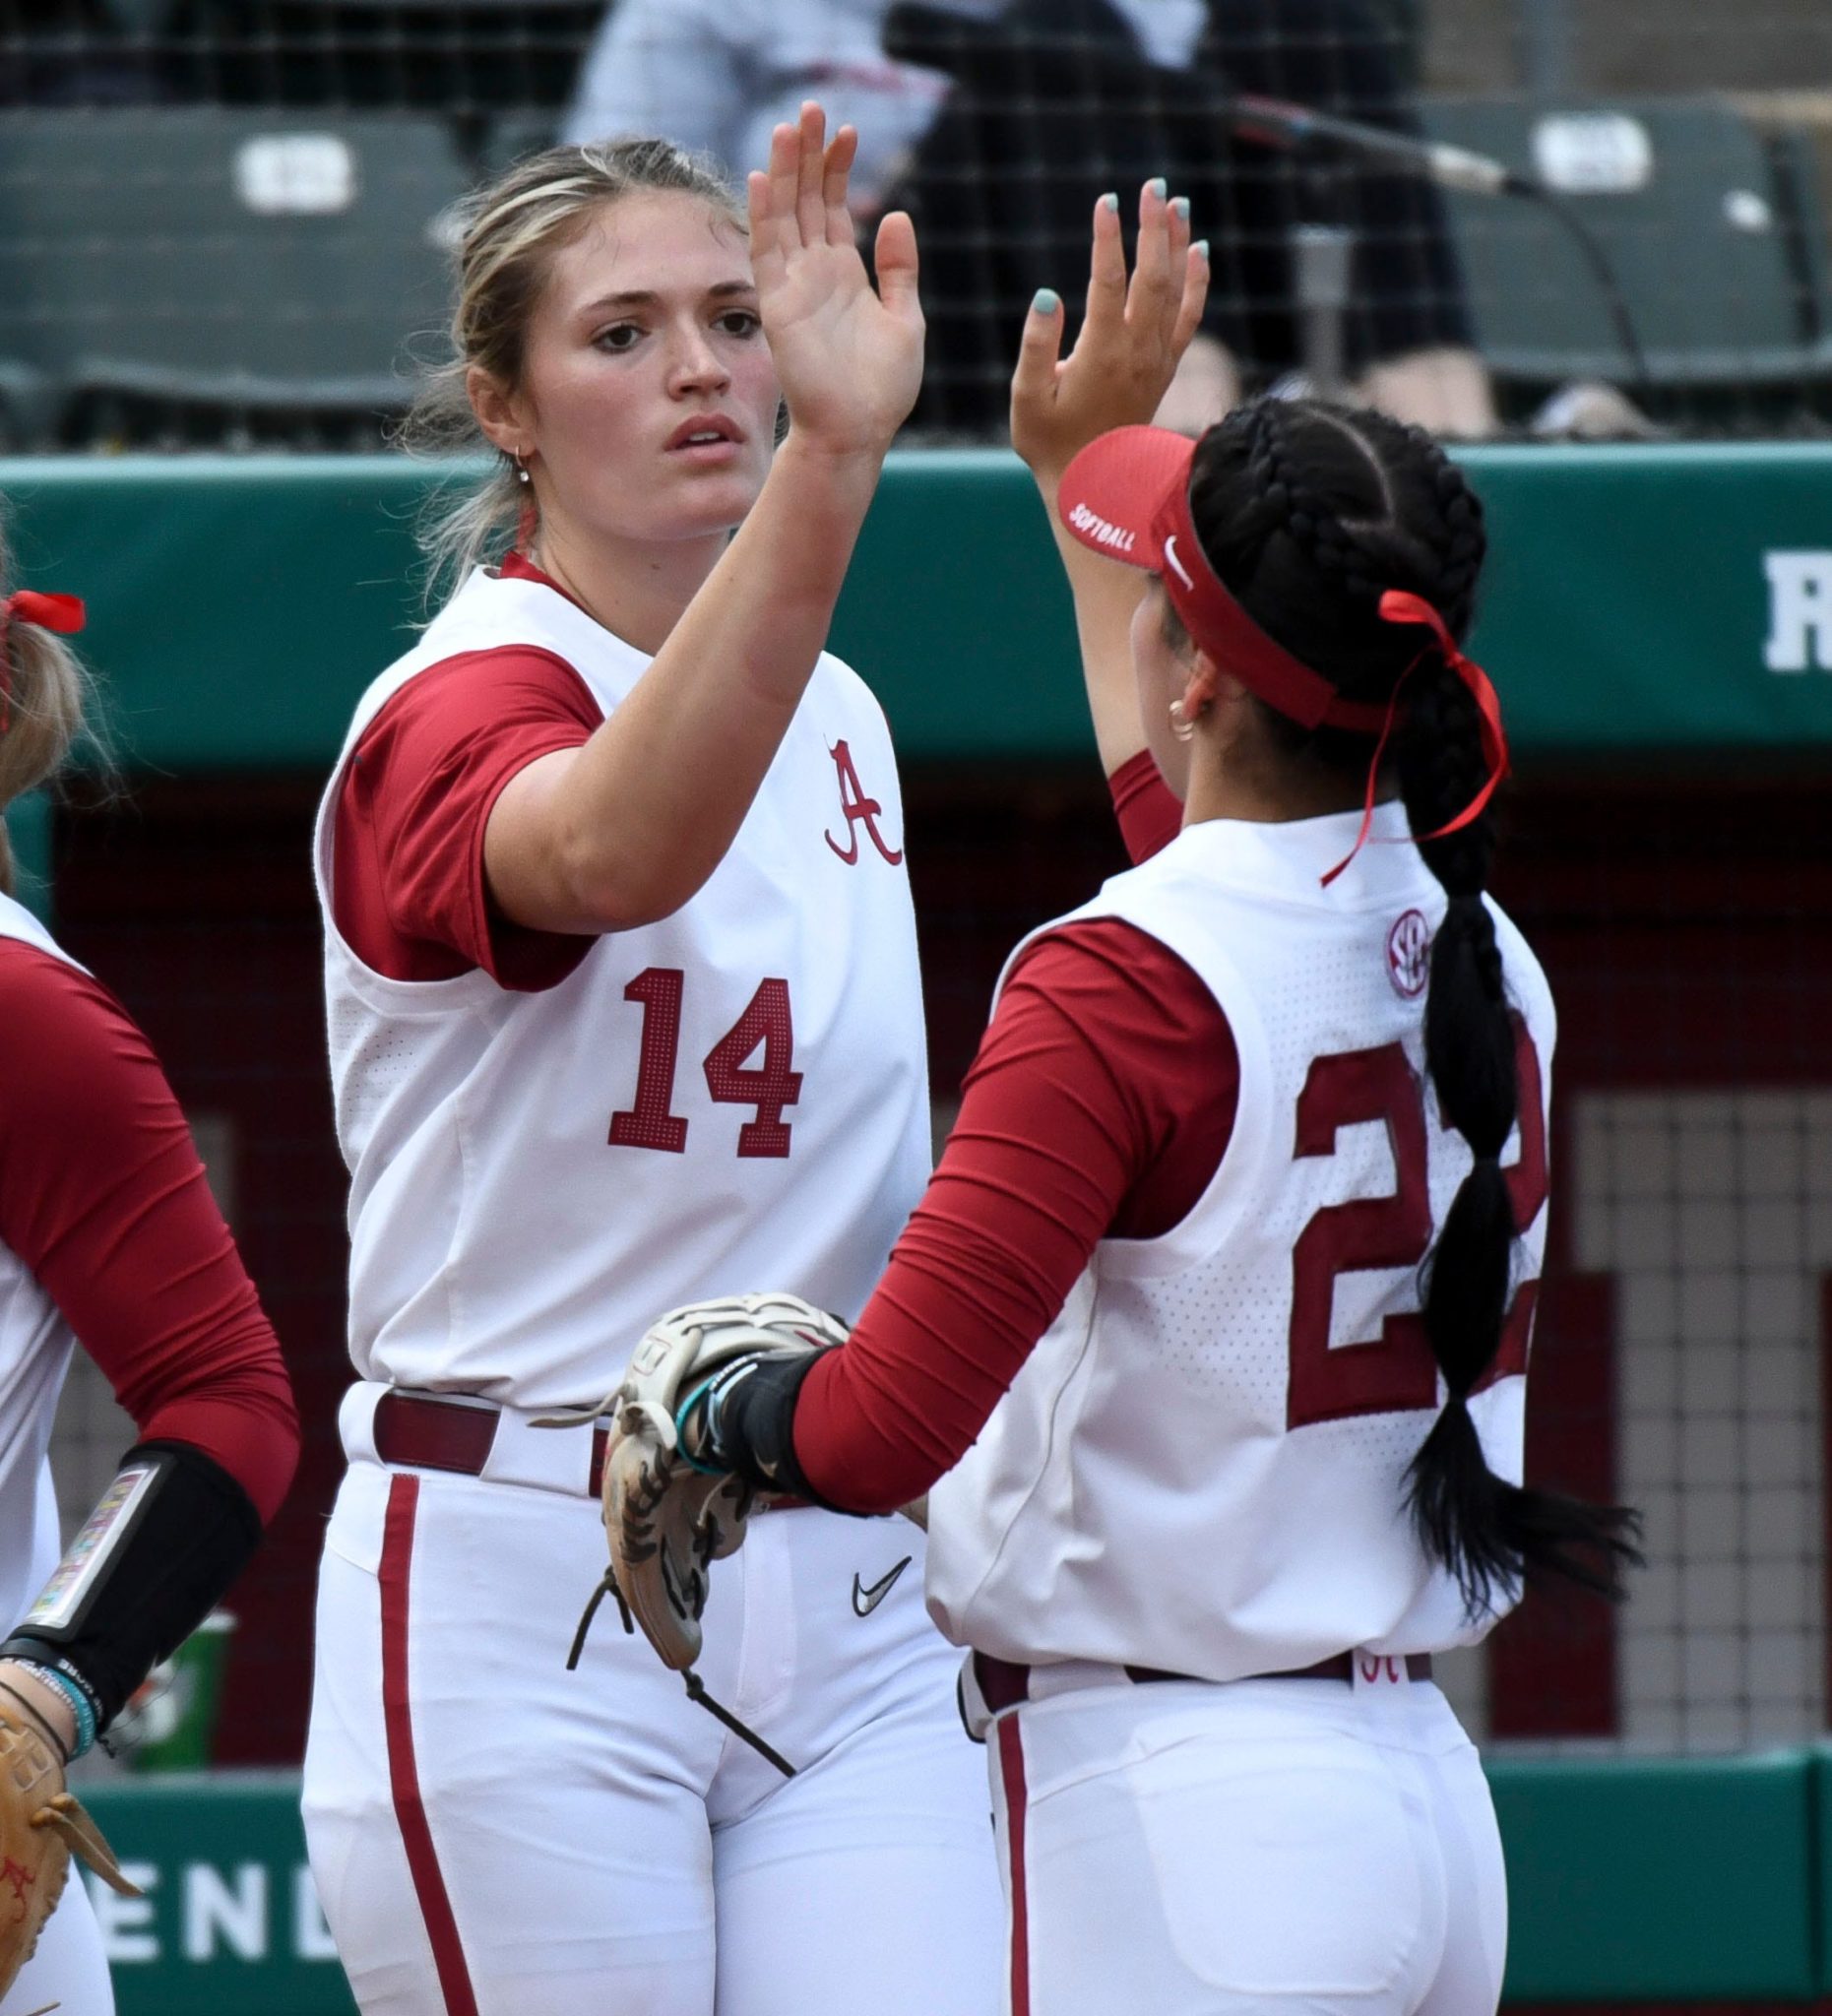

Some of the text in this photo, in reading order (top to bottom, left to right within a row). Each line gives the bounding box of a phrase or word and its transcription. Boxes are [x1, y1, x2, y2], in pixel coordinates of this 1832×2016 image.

[1069, 502, 1136, 552] SOFTBALL
[824, 736, 902, 866] A
[607, 967, 804, 1158] 14
